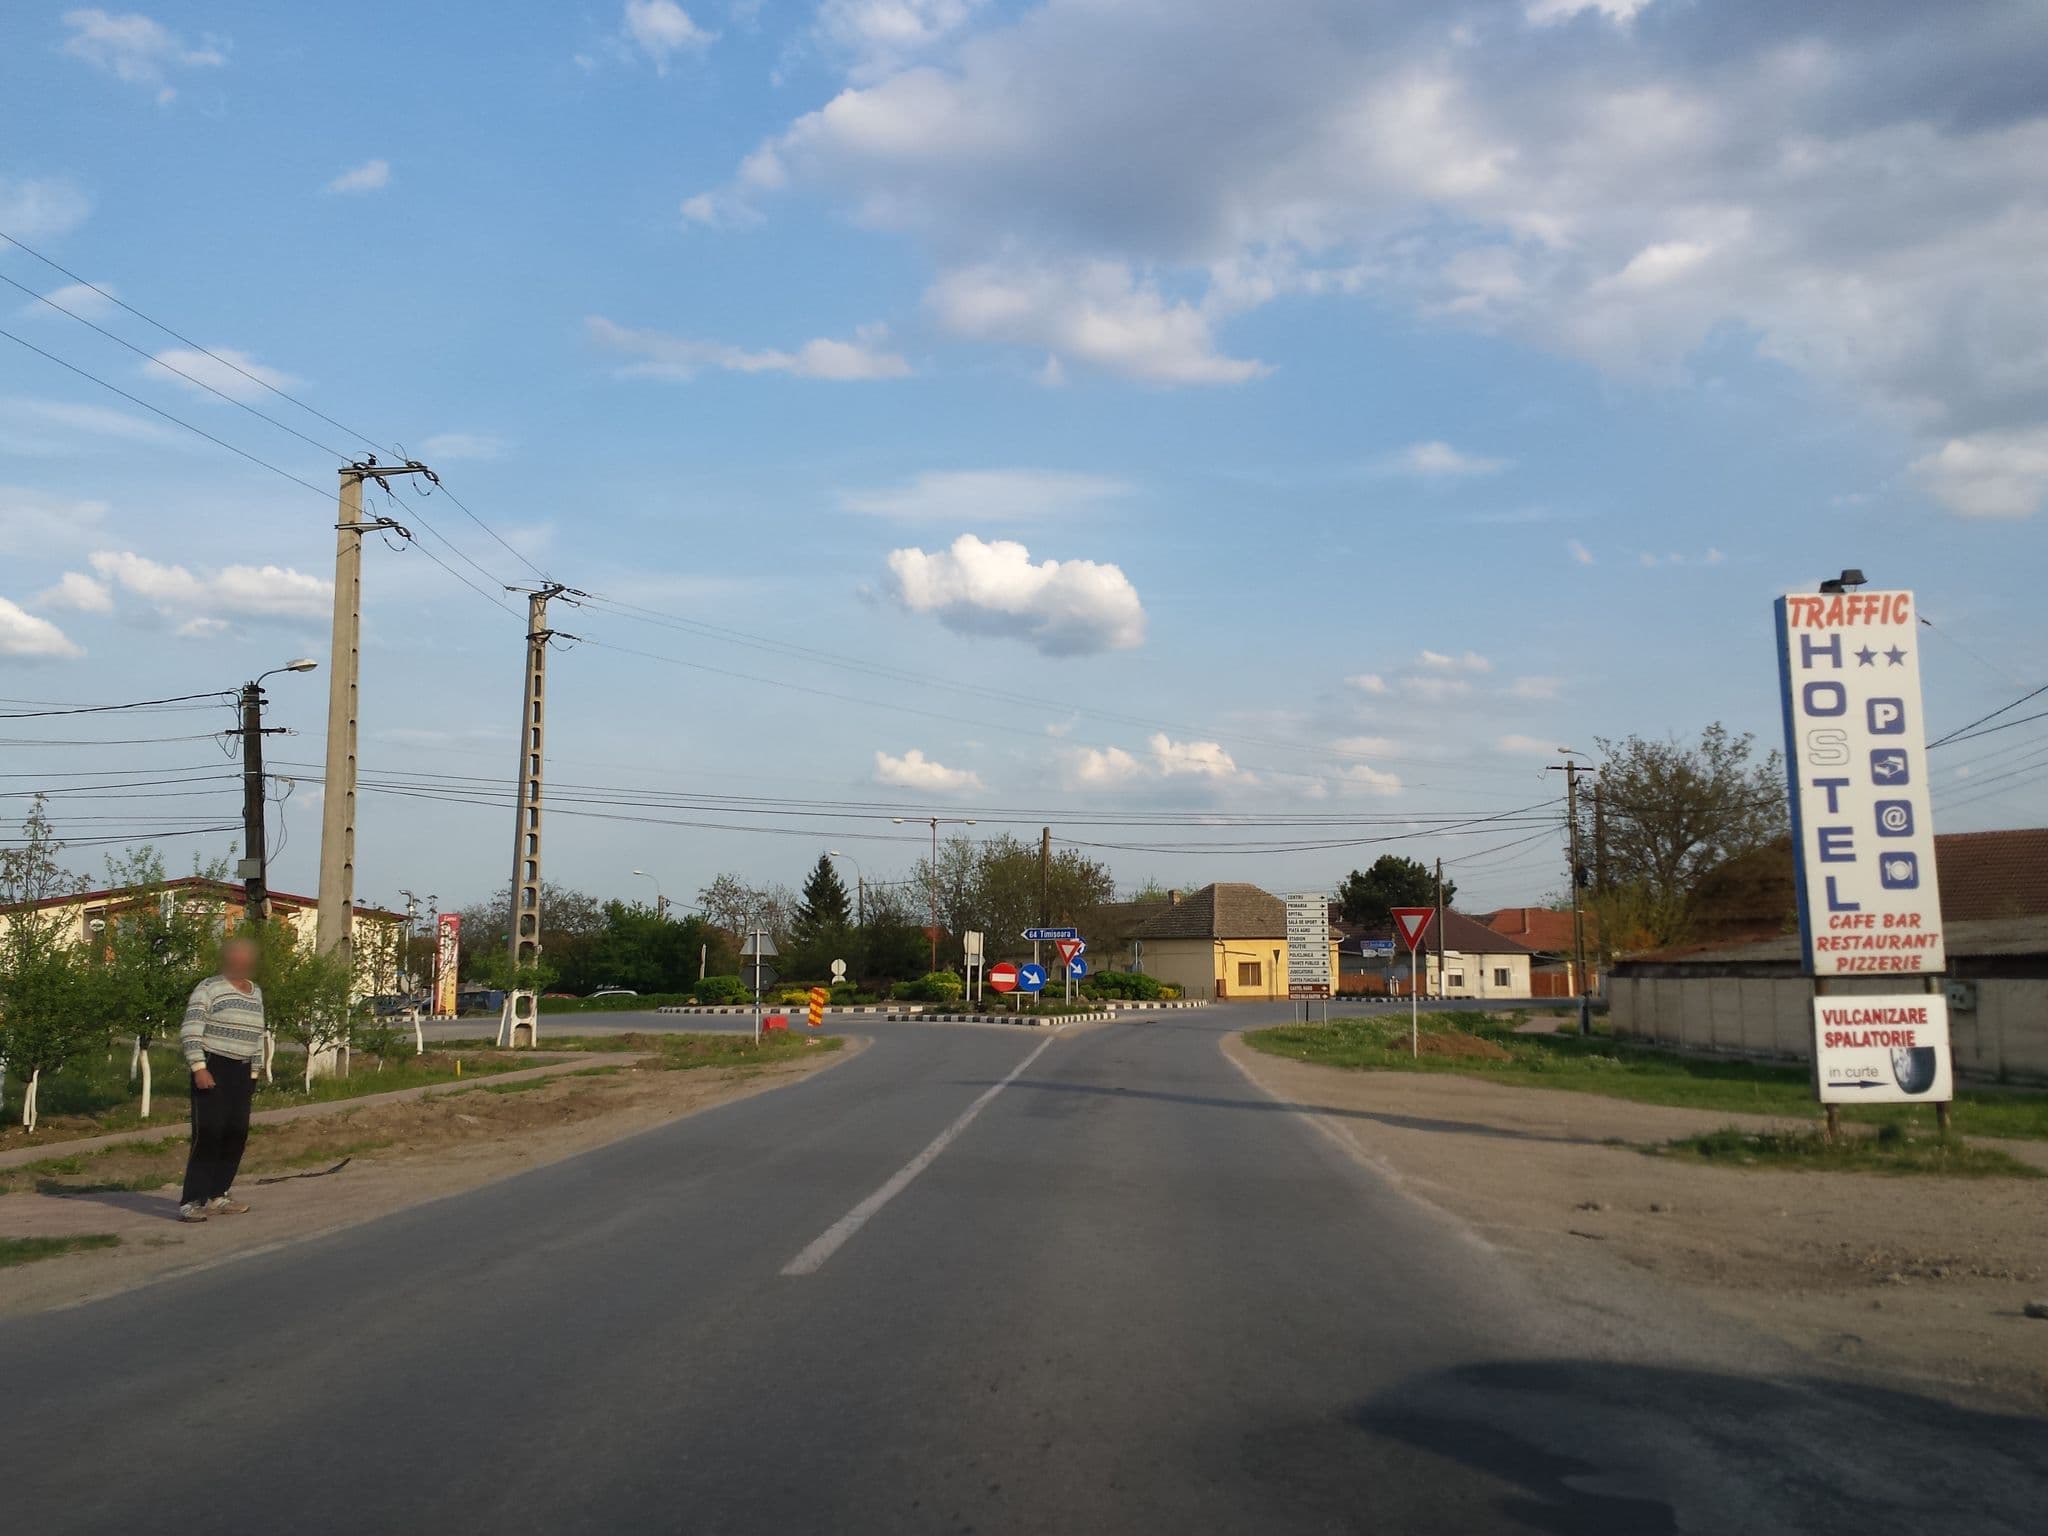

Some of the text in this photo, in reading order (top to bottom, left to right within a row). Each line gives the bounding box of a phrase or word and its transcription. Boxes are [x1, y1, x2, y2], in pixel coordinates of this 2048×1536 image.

[1789, 594, 1909, 629] TRAFFIC
[1800, 634, 1860, 911] HOSTEL
[1829, 913, 1921, 929] CAFE BAR
[1029, 930, 1037, 938] 64
[1817, 933, 1939, 951] RESTAURANT
[1836, 955, 1922, 971] PIZZERIE
[1822, 1008, 1928, 1026] VULCANIZARE
[1825, 1030, 1916, 1048] SPALATORIE
[1829, 1066, 1879, 1078] in curte
